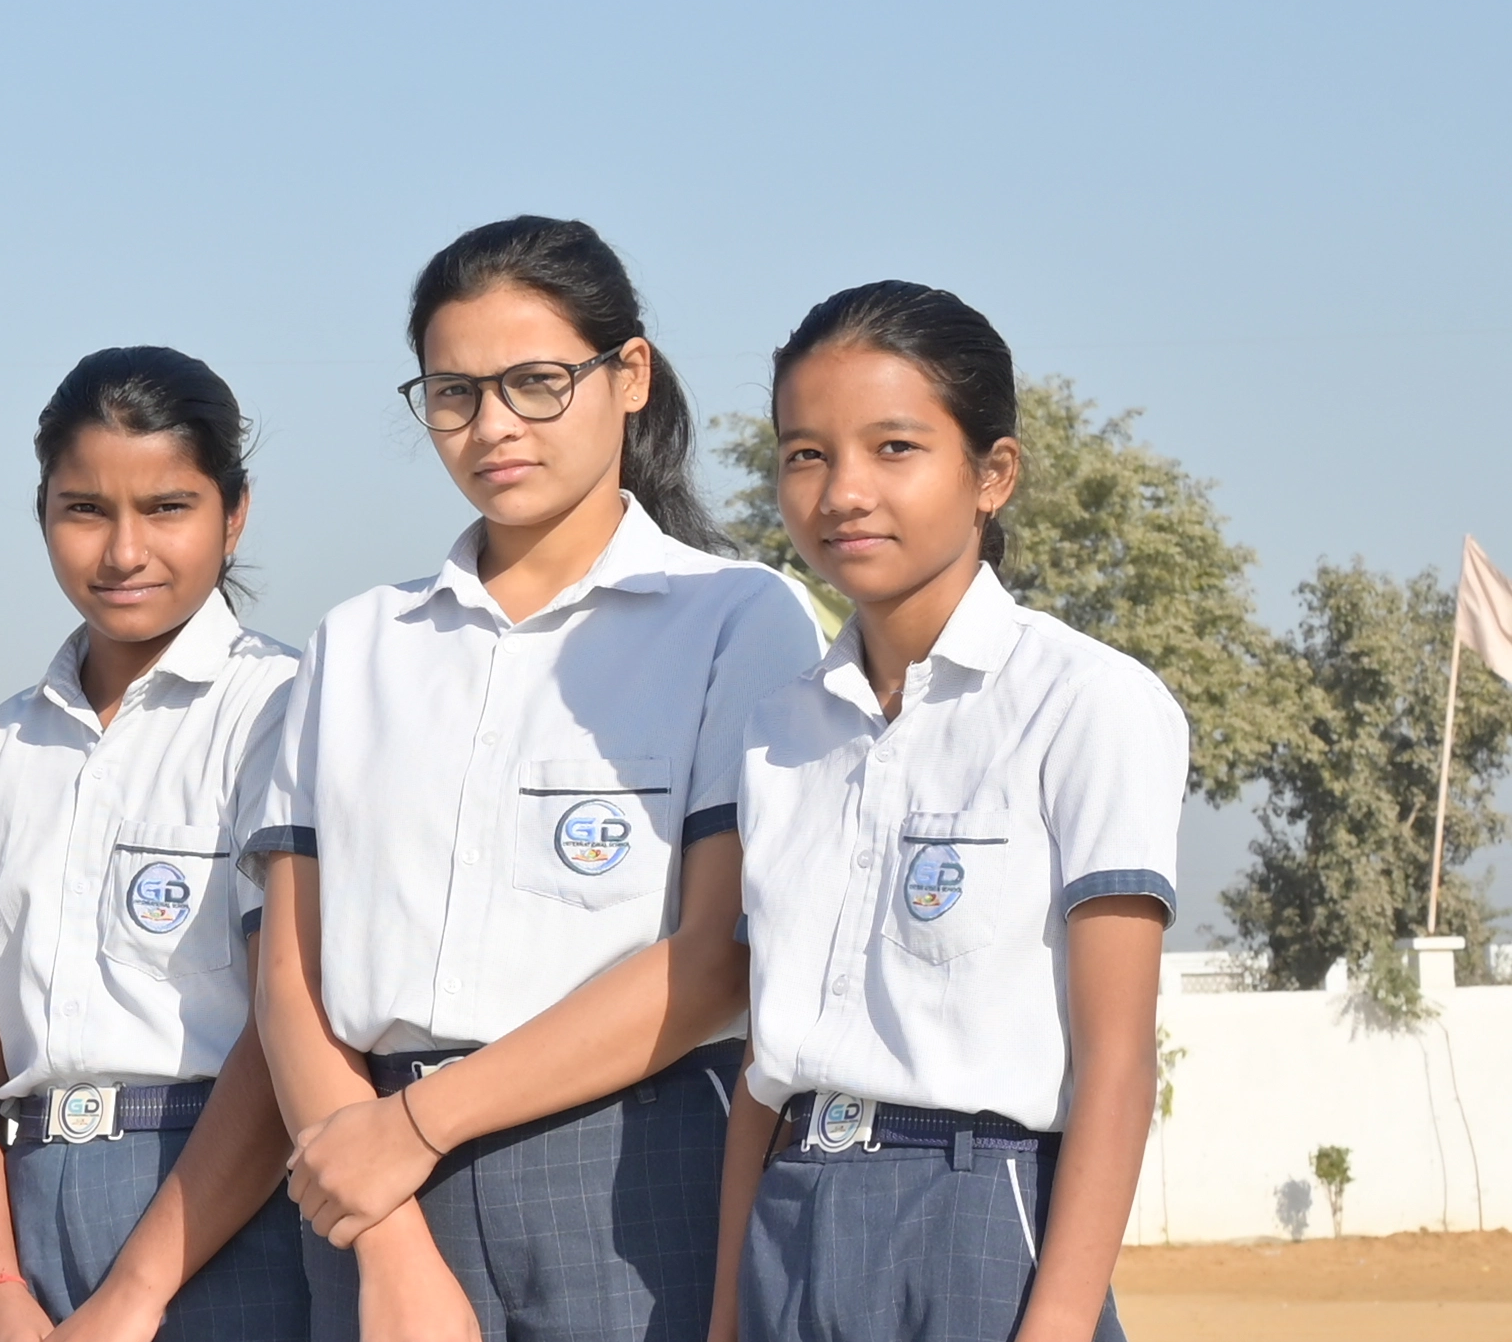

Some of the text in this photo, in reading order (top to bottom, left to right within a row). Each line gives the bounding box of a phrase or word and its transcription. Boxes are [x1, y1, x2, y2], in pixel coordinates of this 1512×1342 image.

[565, 817, 631, 843] GD
[914, 862, 965, 887] GD
[137, 879, 191, 903] GD
[67, 1099, 100, 1114] GD
[828, 1103, 860, 1121] GD
